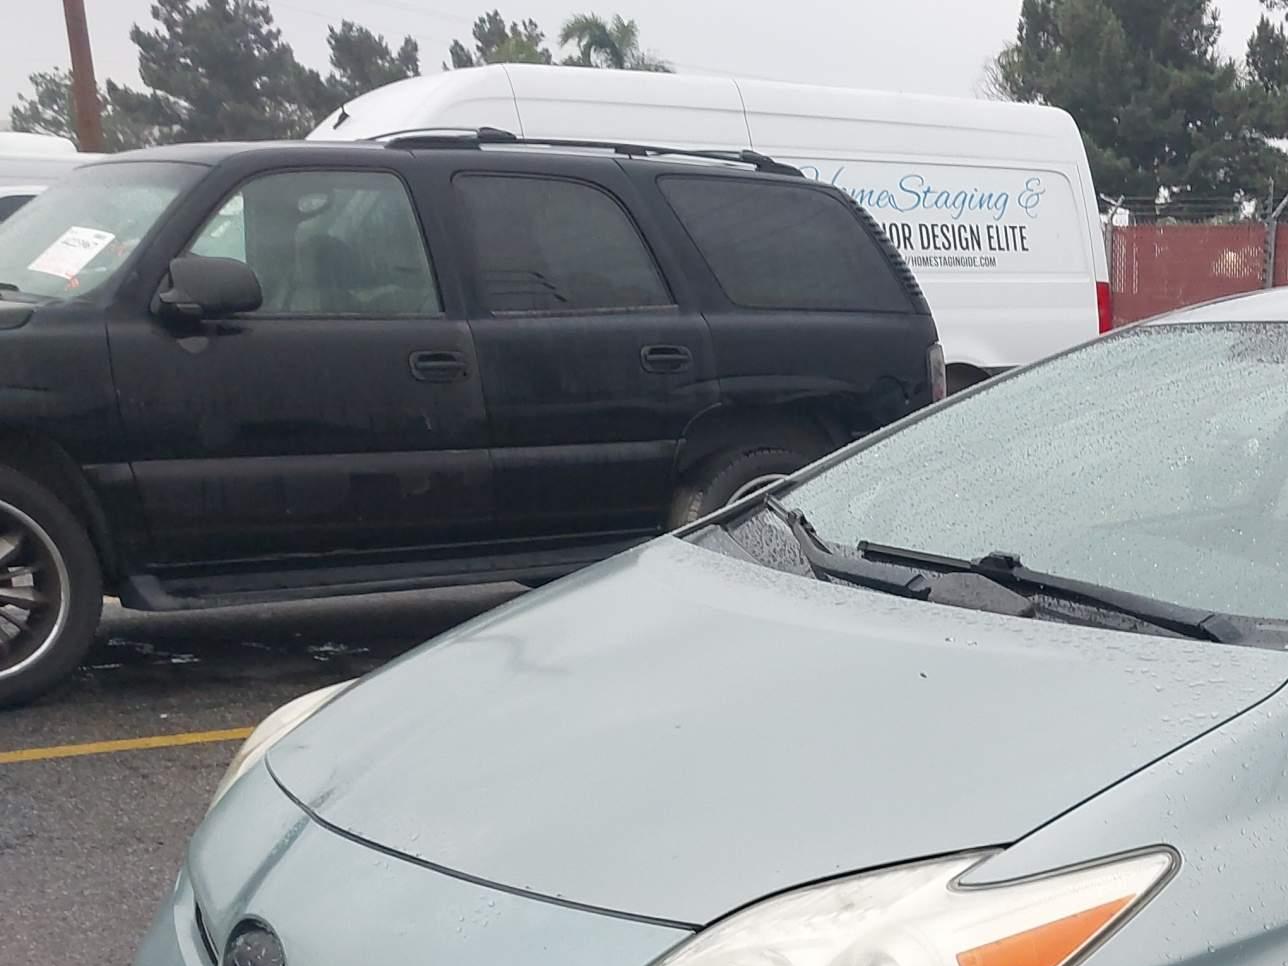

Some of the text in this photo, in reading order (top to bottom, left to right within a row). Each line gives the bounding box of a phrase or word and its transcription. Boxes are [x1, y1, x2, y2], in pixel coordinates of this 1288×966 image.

[1017, 177, 1046, 219] &
[918, 223, 982, 251] DESIGN
[986, 224, 1029, 252] ELITE
